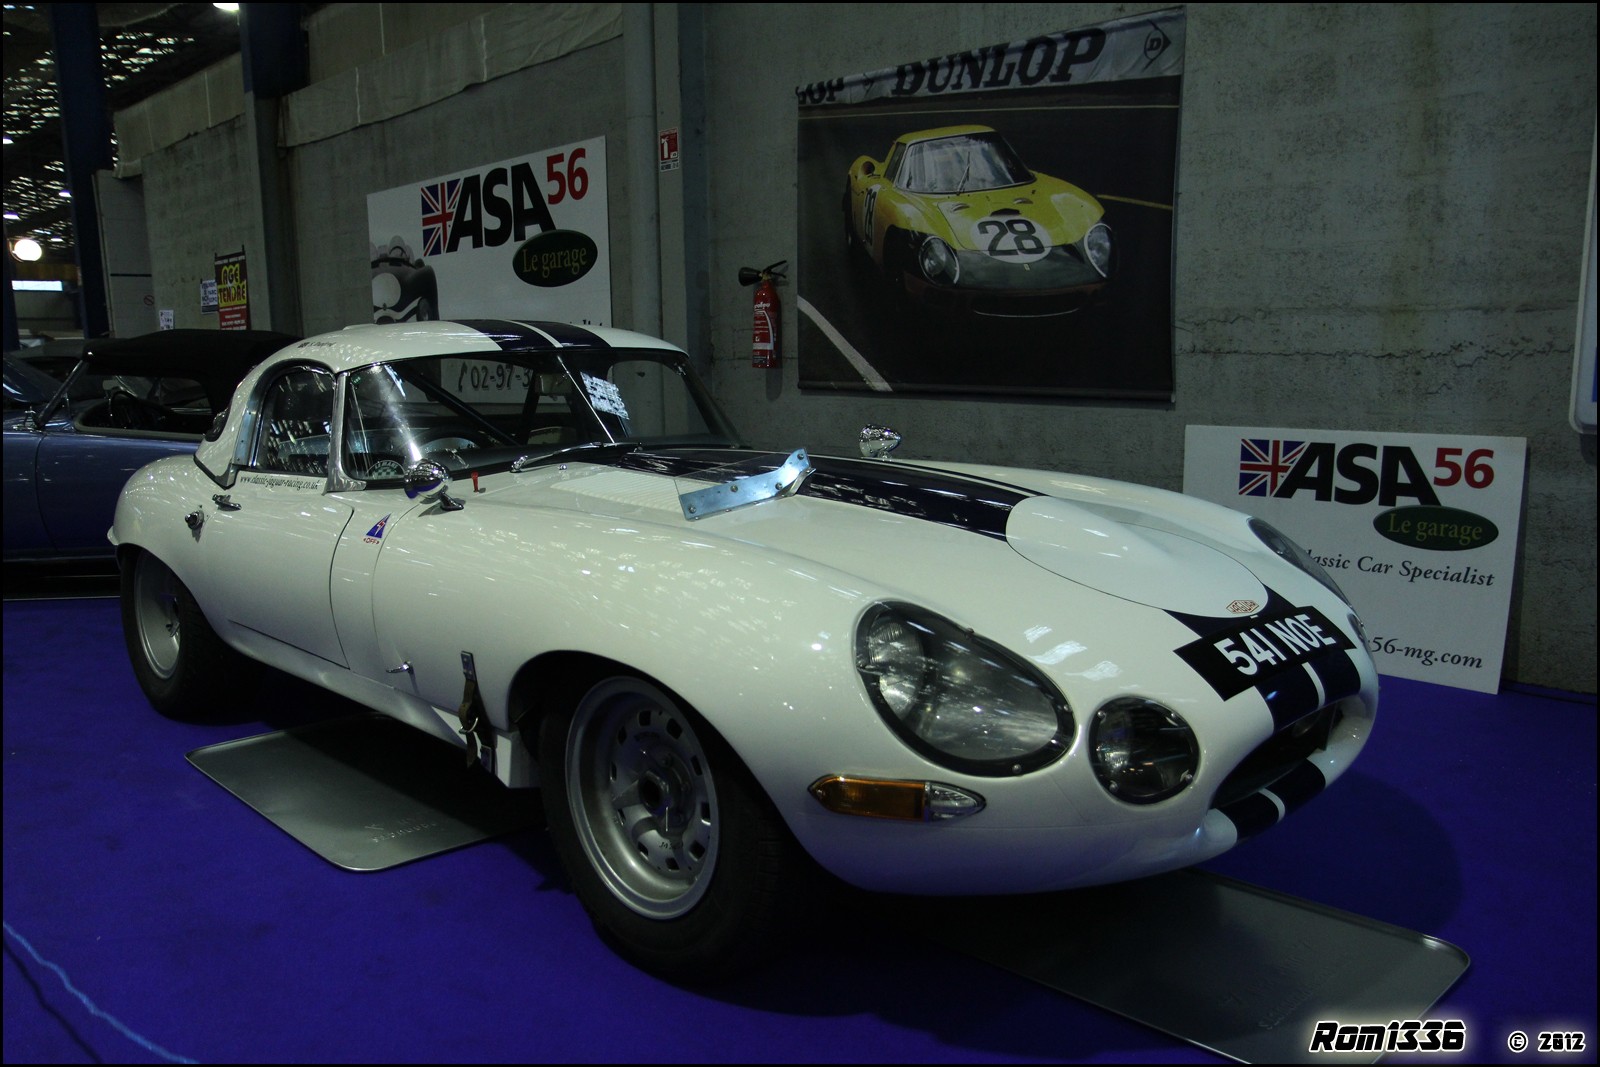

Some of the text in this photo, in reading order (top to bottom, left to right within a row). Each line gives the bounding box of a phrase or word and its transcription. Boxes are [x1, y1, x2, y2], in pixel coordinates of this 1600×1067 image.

[891, 28, 1106, 96] DUNLOP
[446, 163, 556, 253] ASA
[547, 148, 589, 205] 56
[978, 219, 1045, 257] 28
[222, 266, 240, 286] AGE
[524, 247, 588, 278] Le garage
[218, 285, 247, 304] TENDRE
[1274, 443, 1494, 507] ASA 56
[1388, 513, 1483, 545] Le garage
[1307, 549, 1495, 586] lassic Car Specialist
[1265, 614, 1336, 656] NOE
[1369, 636, 1482, 668] 56-mg.com
